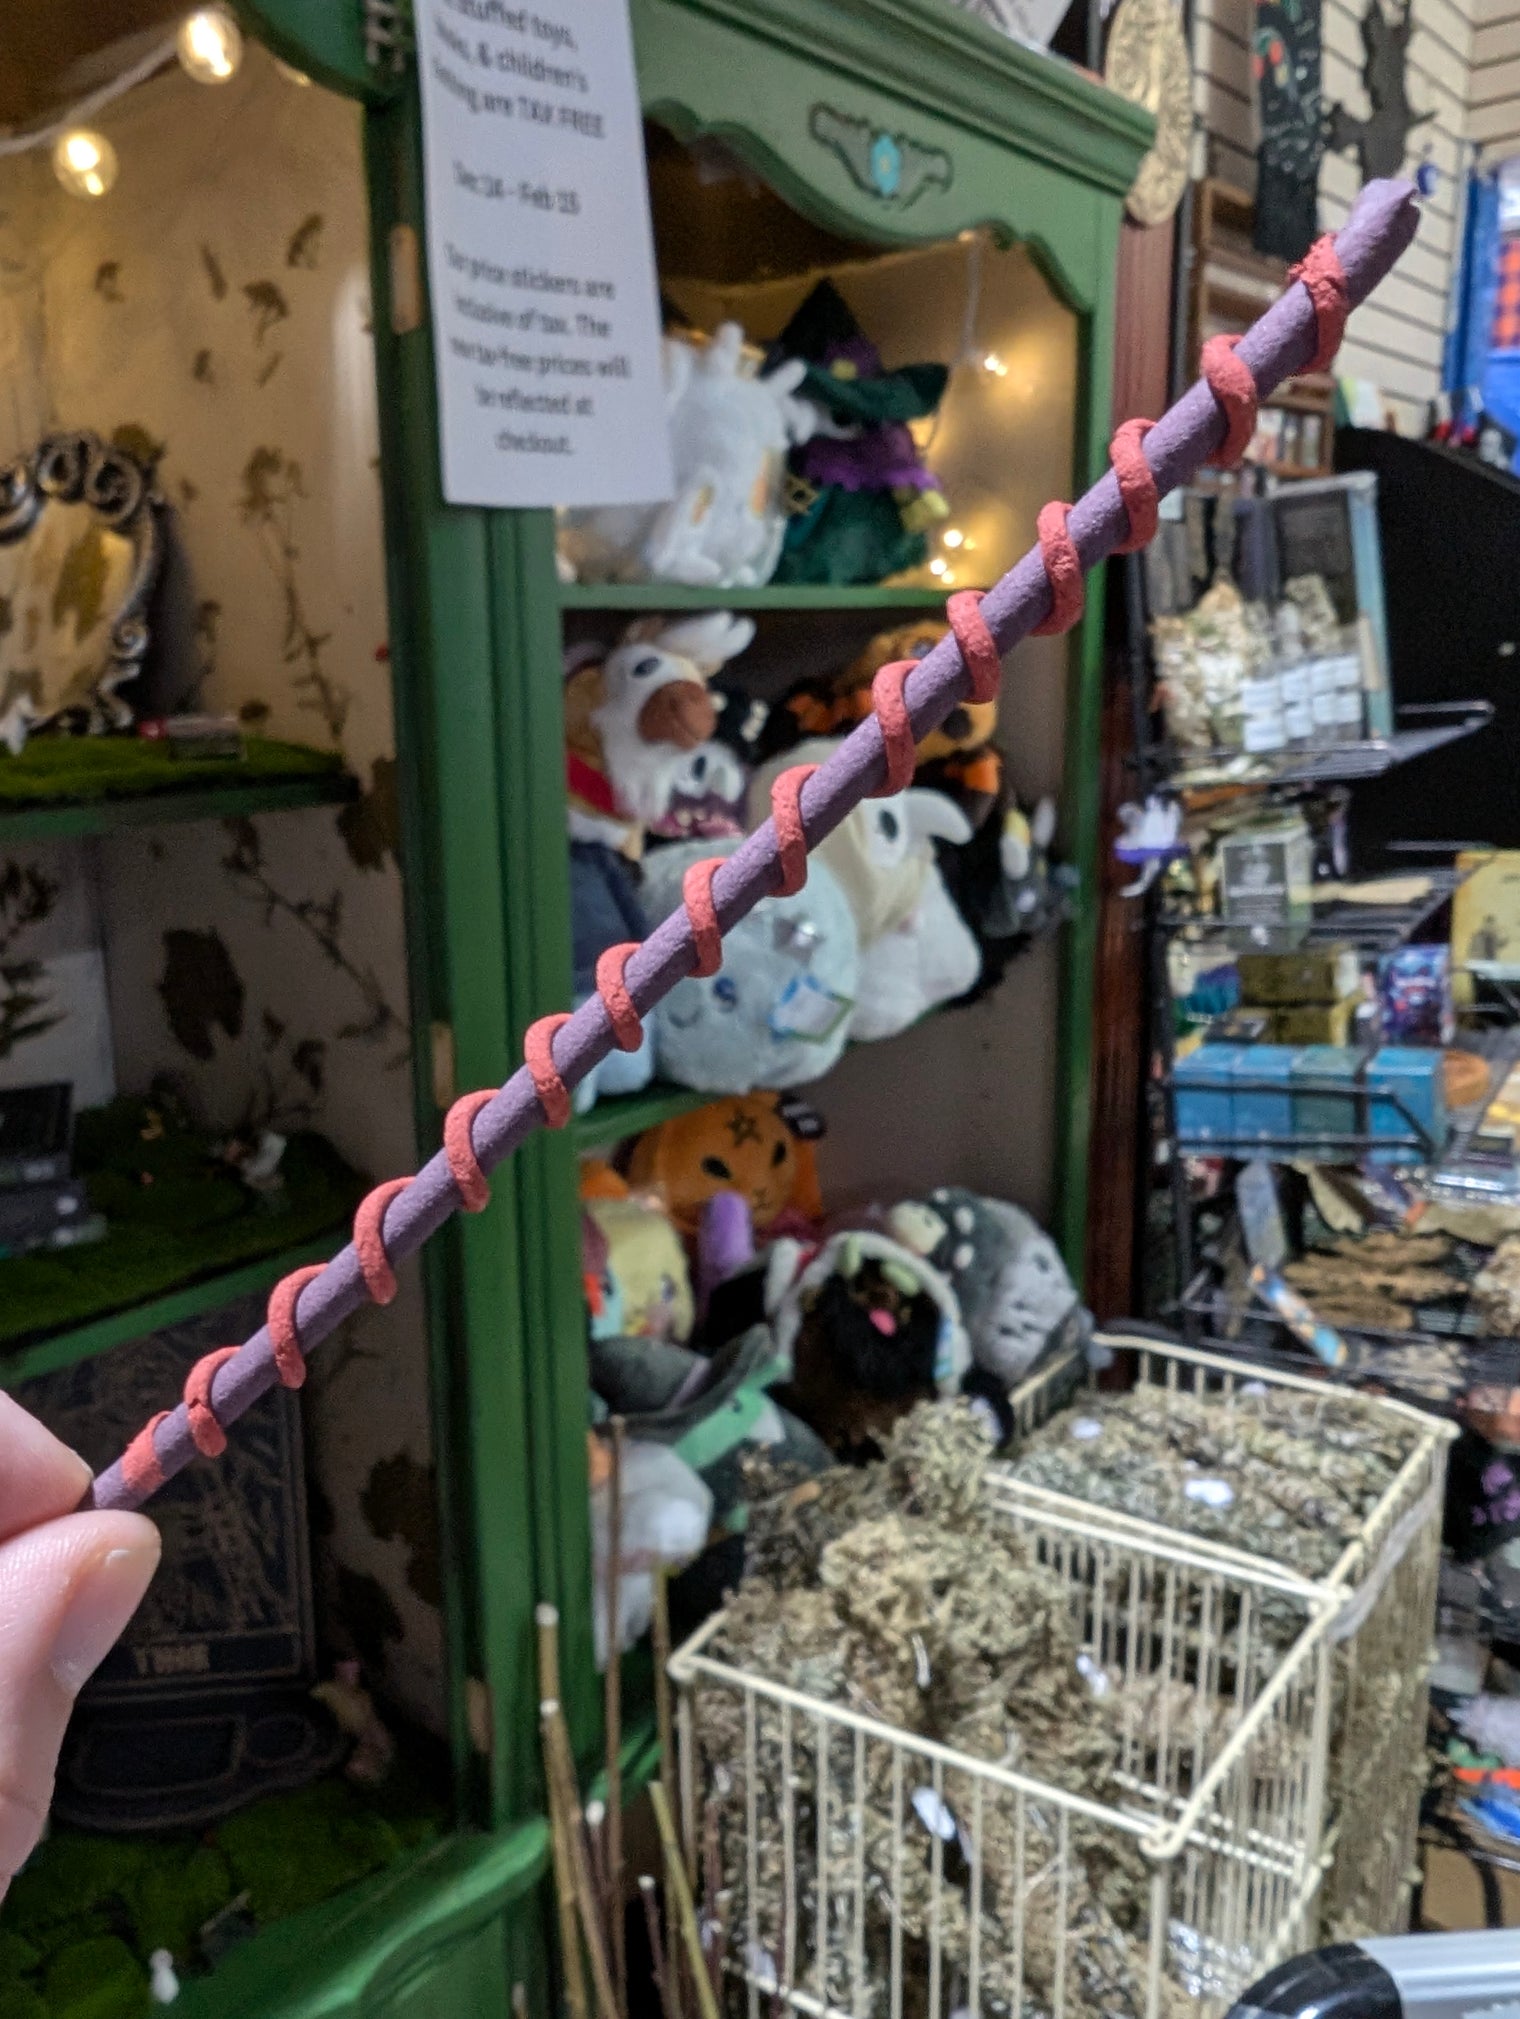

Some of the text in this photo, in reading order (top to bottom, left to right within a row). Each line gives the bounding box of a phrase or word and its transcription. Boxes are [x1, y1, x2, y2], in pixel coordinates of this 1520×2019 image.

[496, 46, 590, 93] children's
[557, 105, 607, 140] FREE
[510, 265, 580, 296] stickers
[584, 280, 616, 301] are
[518, 307, 538, 332] of
[575, 312, 612, 338] The
[536, 353, 593, 379] prices
[597, 354, 633, 379] will
[499, 384, 572, 416] reflected
[574, 394, 596, 417] at
[494, 429, 575, 456] checkout.
